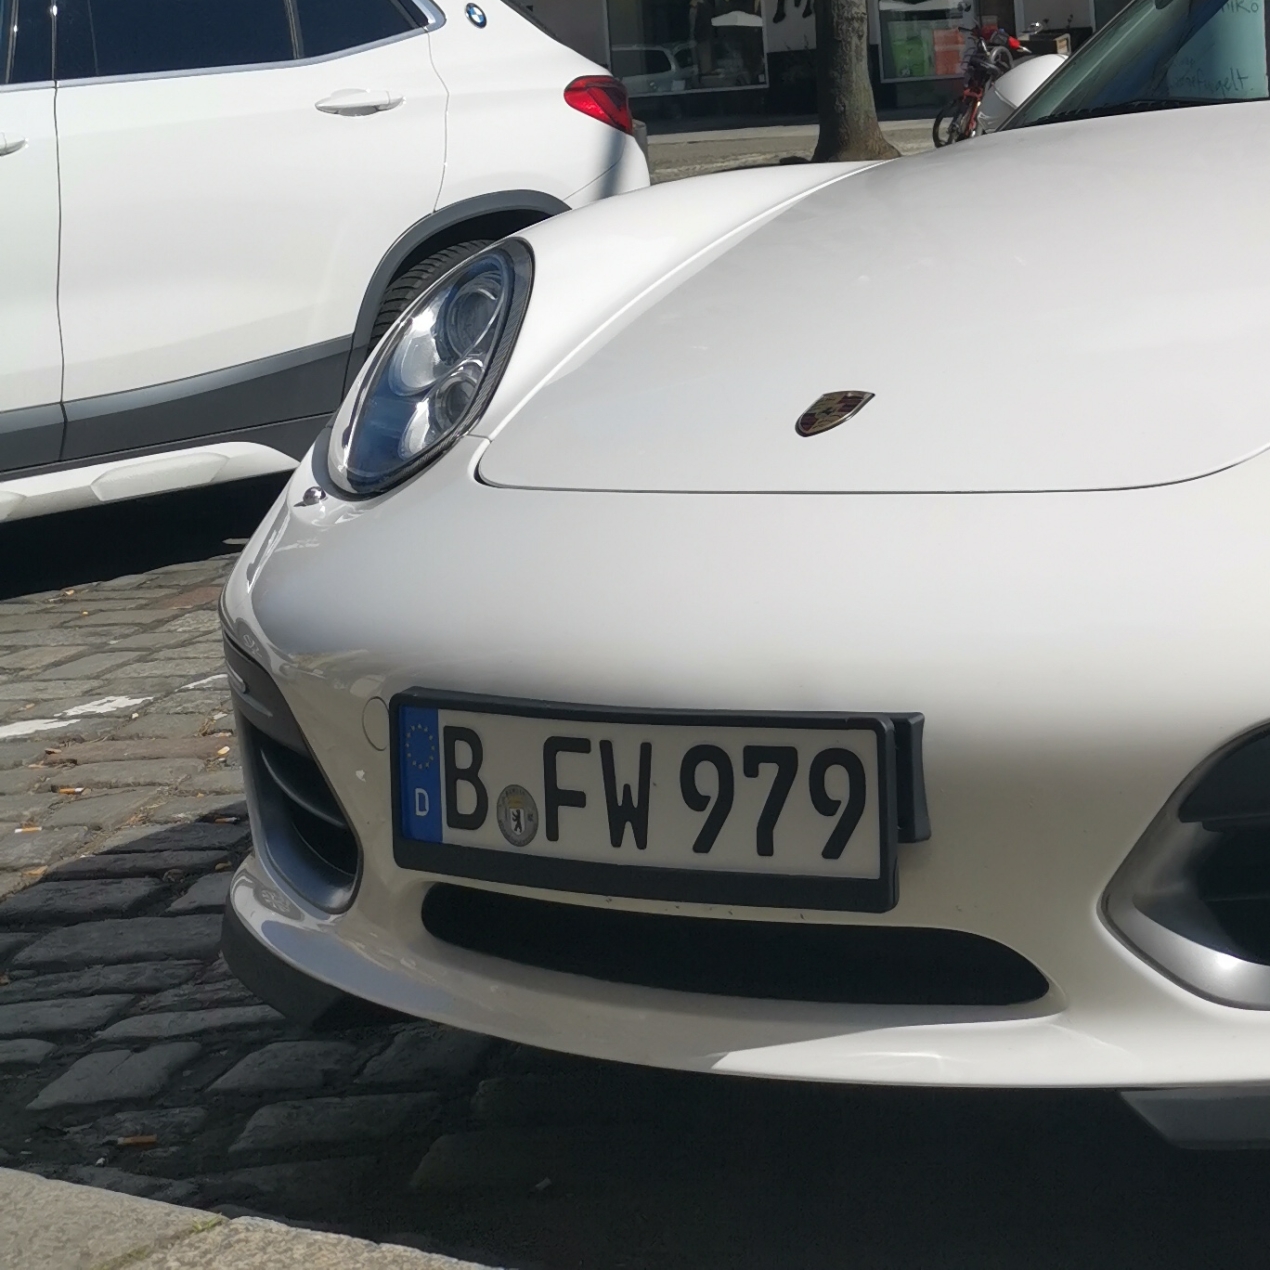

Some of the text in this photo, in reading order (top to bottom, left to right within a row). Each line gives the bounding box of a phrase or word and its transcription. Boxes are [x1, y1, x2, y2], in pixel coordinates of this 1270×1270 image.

[414, 787, 430, 817] D
[443, 725, 489, 831] B
[543, 735, 653, 850] FW
[680, 744, 867, 860] 979
